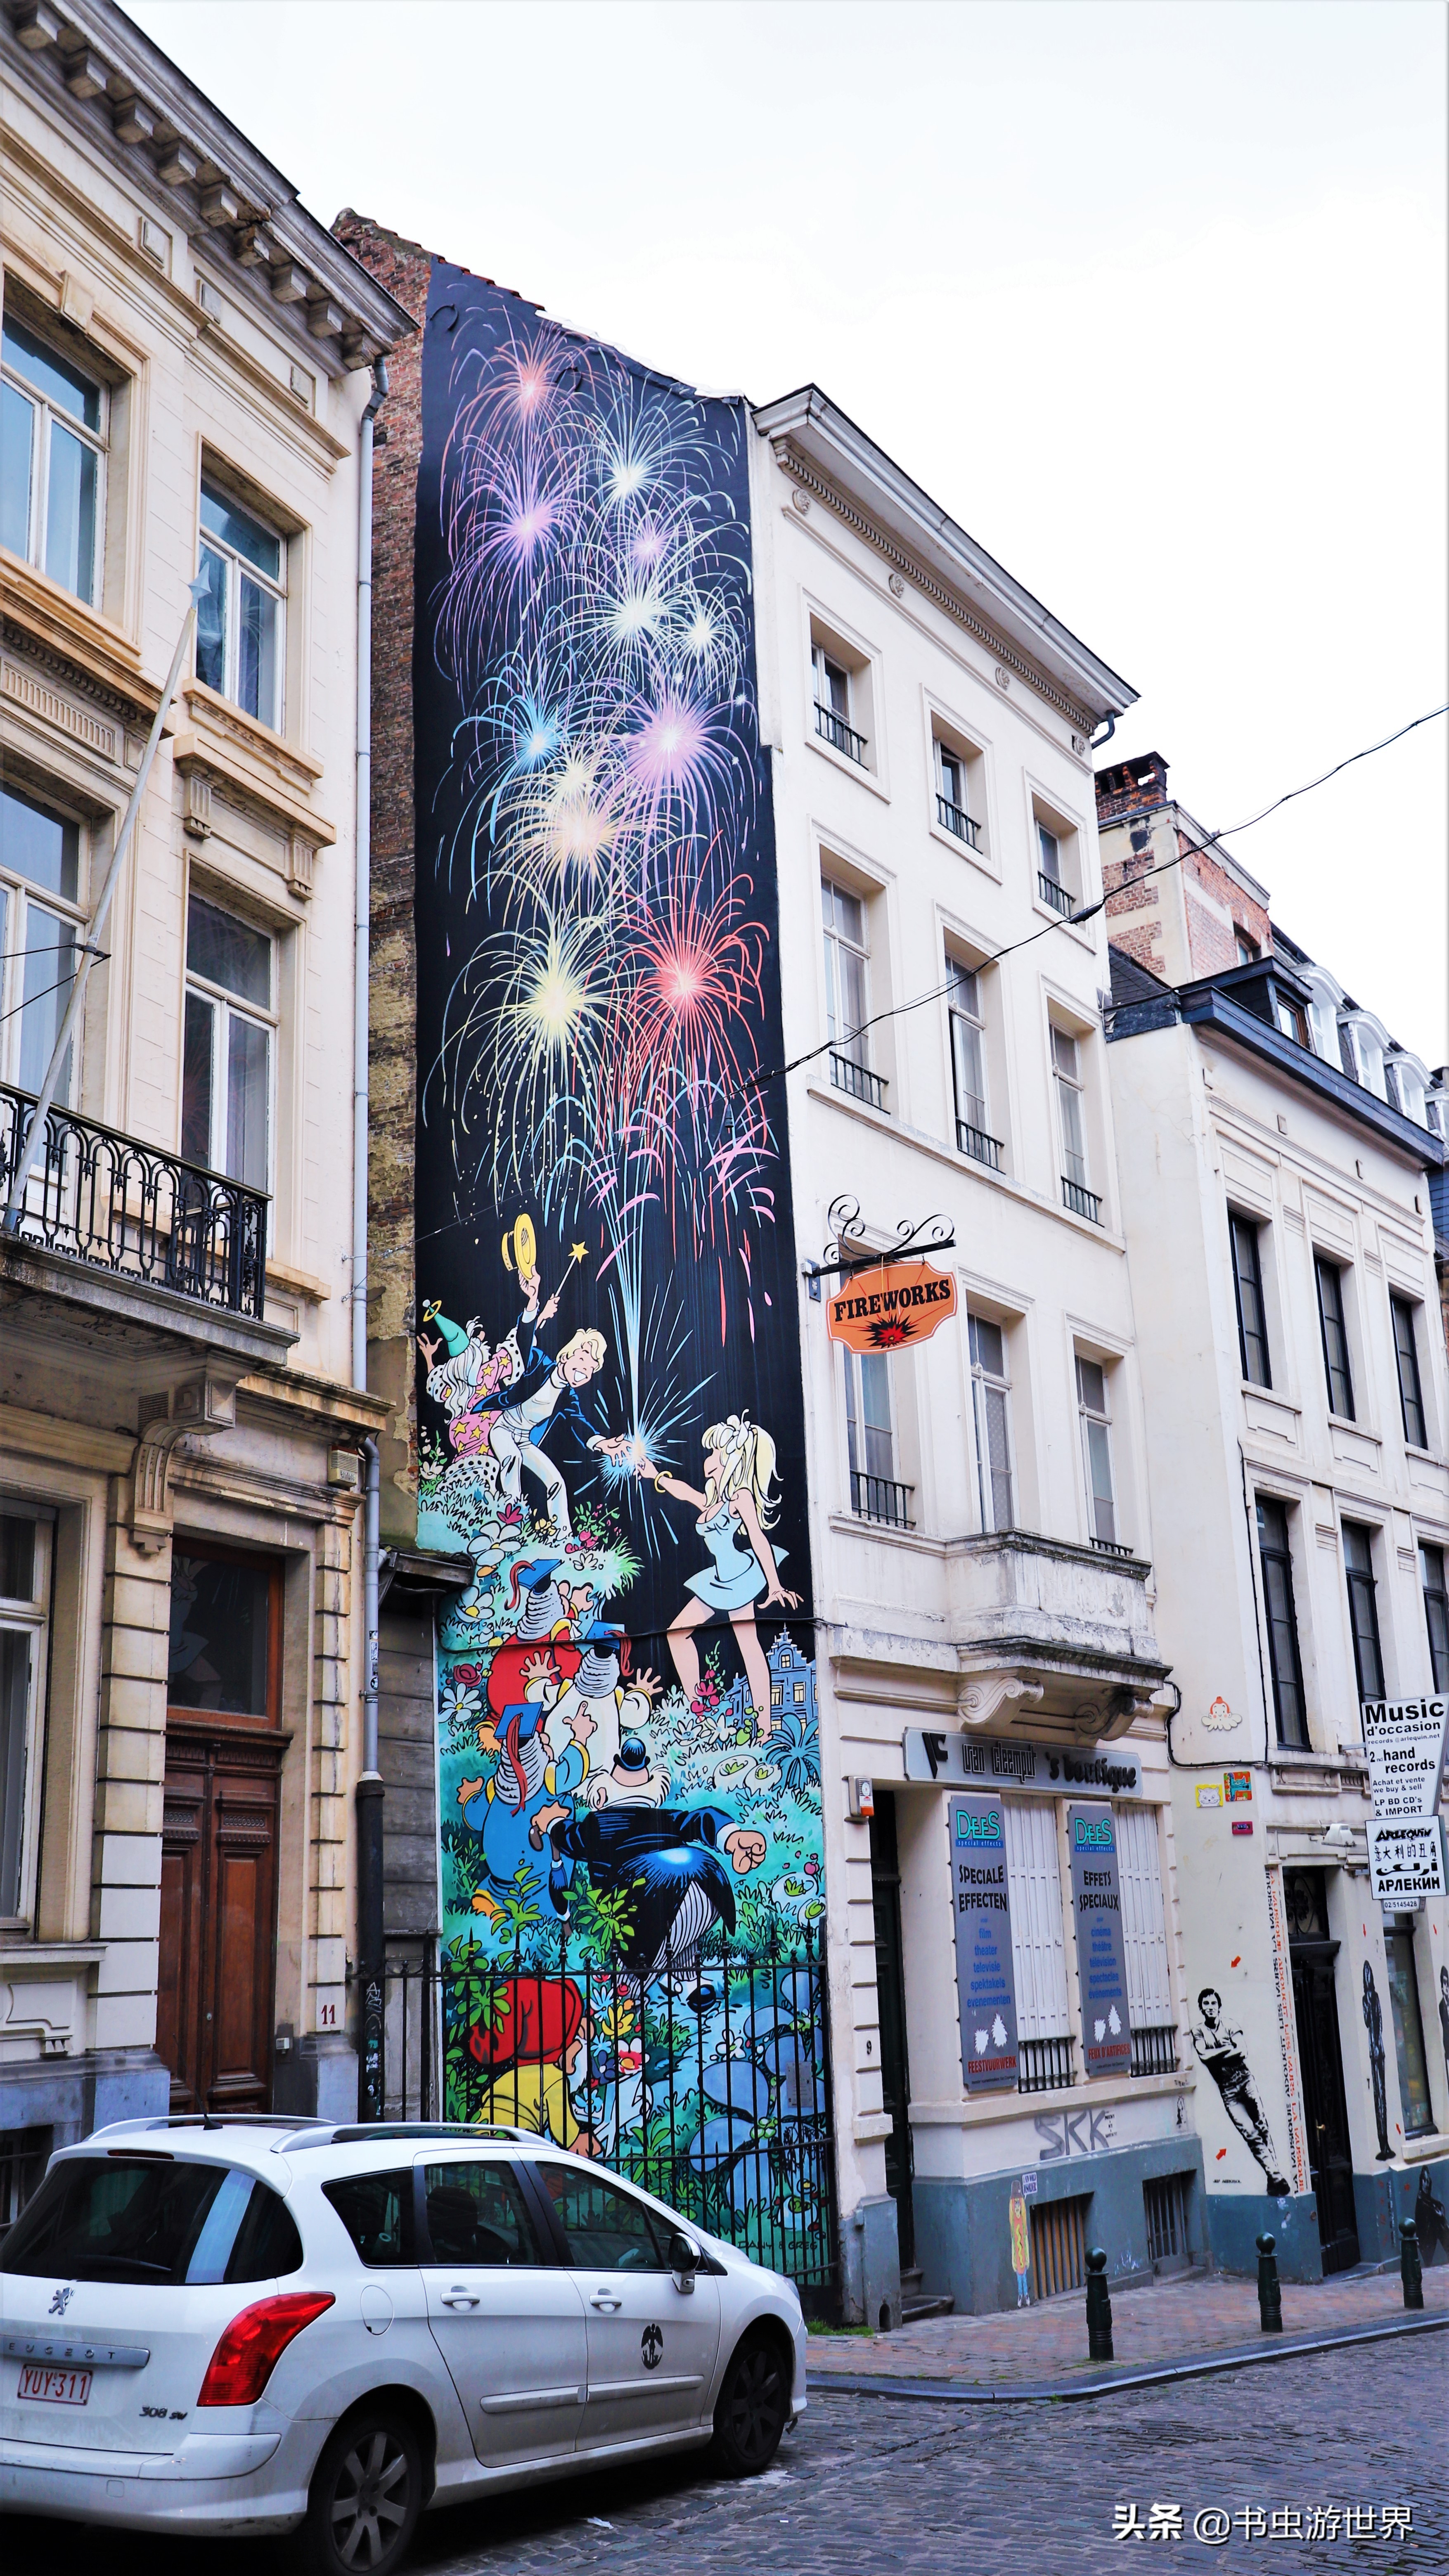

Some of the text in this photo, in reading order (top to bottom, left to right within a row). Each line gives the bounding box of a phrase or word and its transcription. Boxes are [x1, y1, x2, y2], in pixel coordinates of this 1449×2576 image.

[834, 1279, 950, 1322] FIREWORKS
[1365, 1698, 1444, 1724] Music
[1367, 1721, 1440, 1736] d'occasion
[1383, 1746, 1416, 1761] hand
[1063, 1754, 1136, 1793] boutique
[1385, 1759, 1435, 1773] records
[1385, 1805, 1423, 1816] IMPORT
[959, 1864, 1004, 1884] SPECIALE
[1083, 1870, 1111, 1886] EFFETS
[1378, 1877, 1440, 1892] АРЛЕКИН
[959, 1892, 1007, 1913] EFFECTEN
[1079, 1893, 1119, 1912] SPECIAUX
[979, 1928, 992, 1939] film
[1091, 1926, 1111, 1937] cinéma
[975, 1945, 997, 1956] theater
[973, 1962, 1001, 1973] televisie
[971, 1978, 1006, 1992] spektakels
[1089, 1972, 1119, 1985] spectacles
[967, 1995, 1011, 2008] evenementen
[321, 2004, 336, 2025] 11
[866, 2040, 872, 2055] 9
[1088, 2048, 1101, 2060] FEUX
[968, 2055, 1017, 2074] FEESTVUURWERK
[139, 2406, 168, 2418] 308
